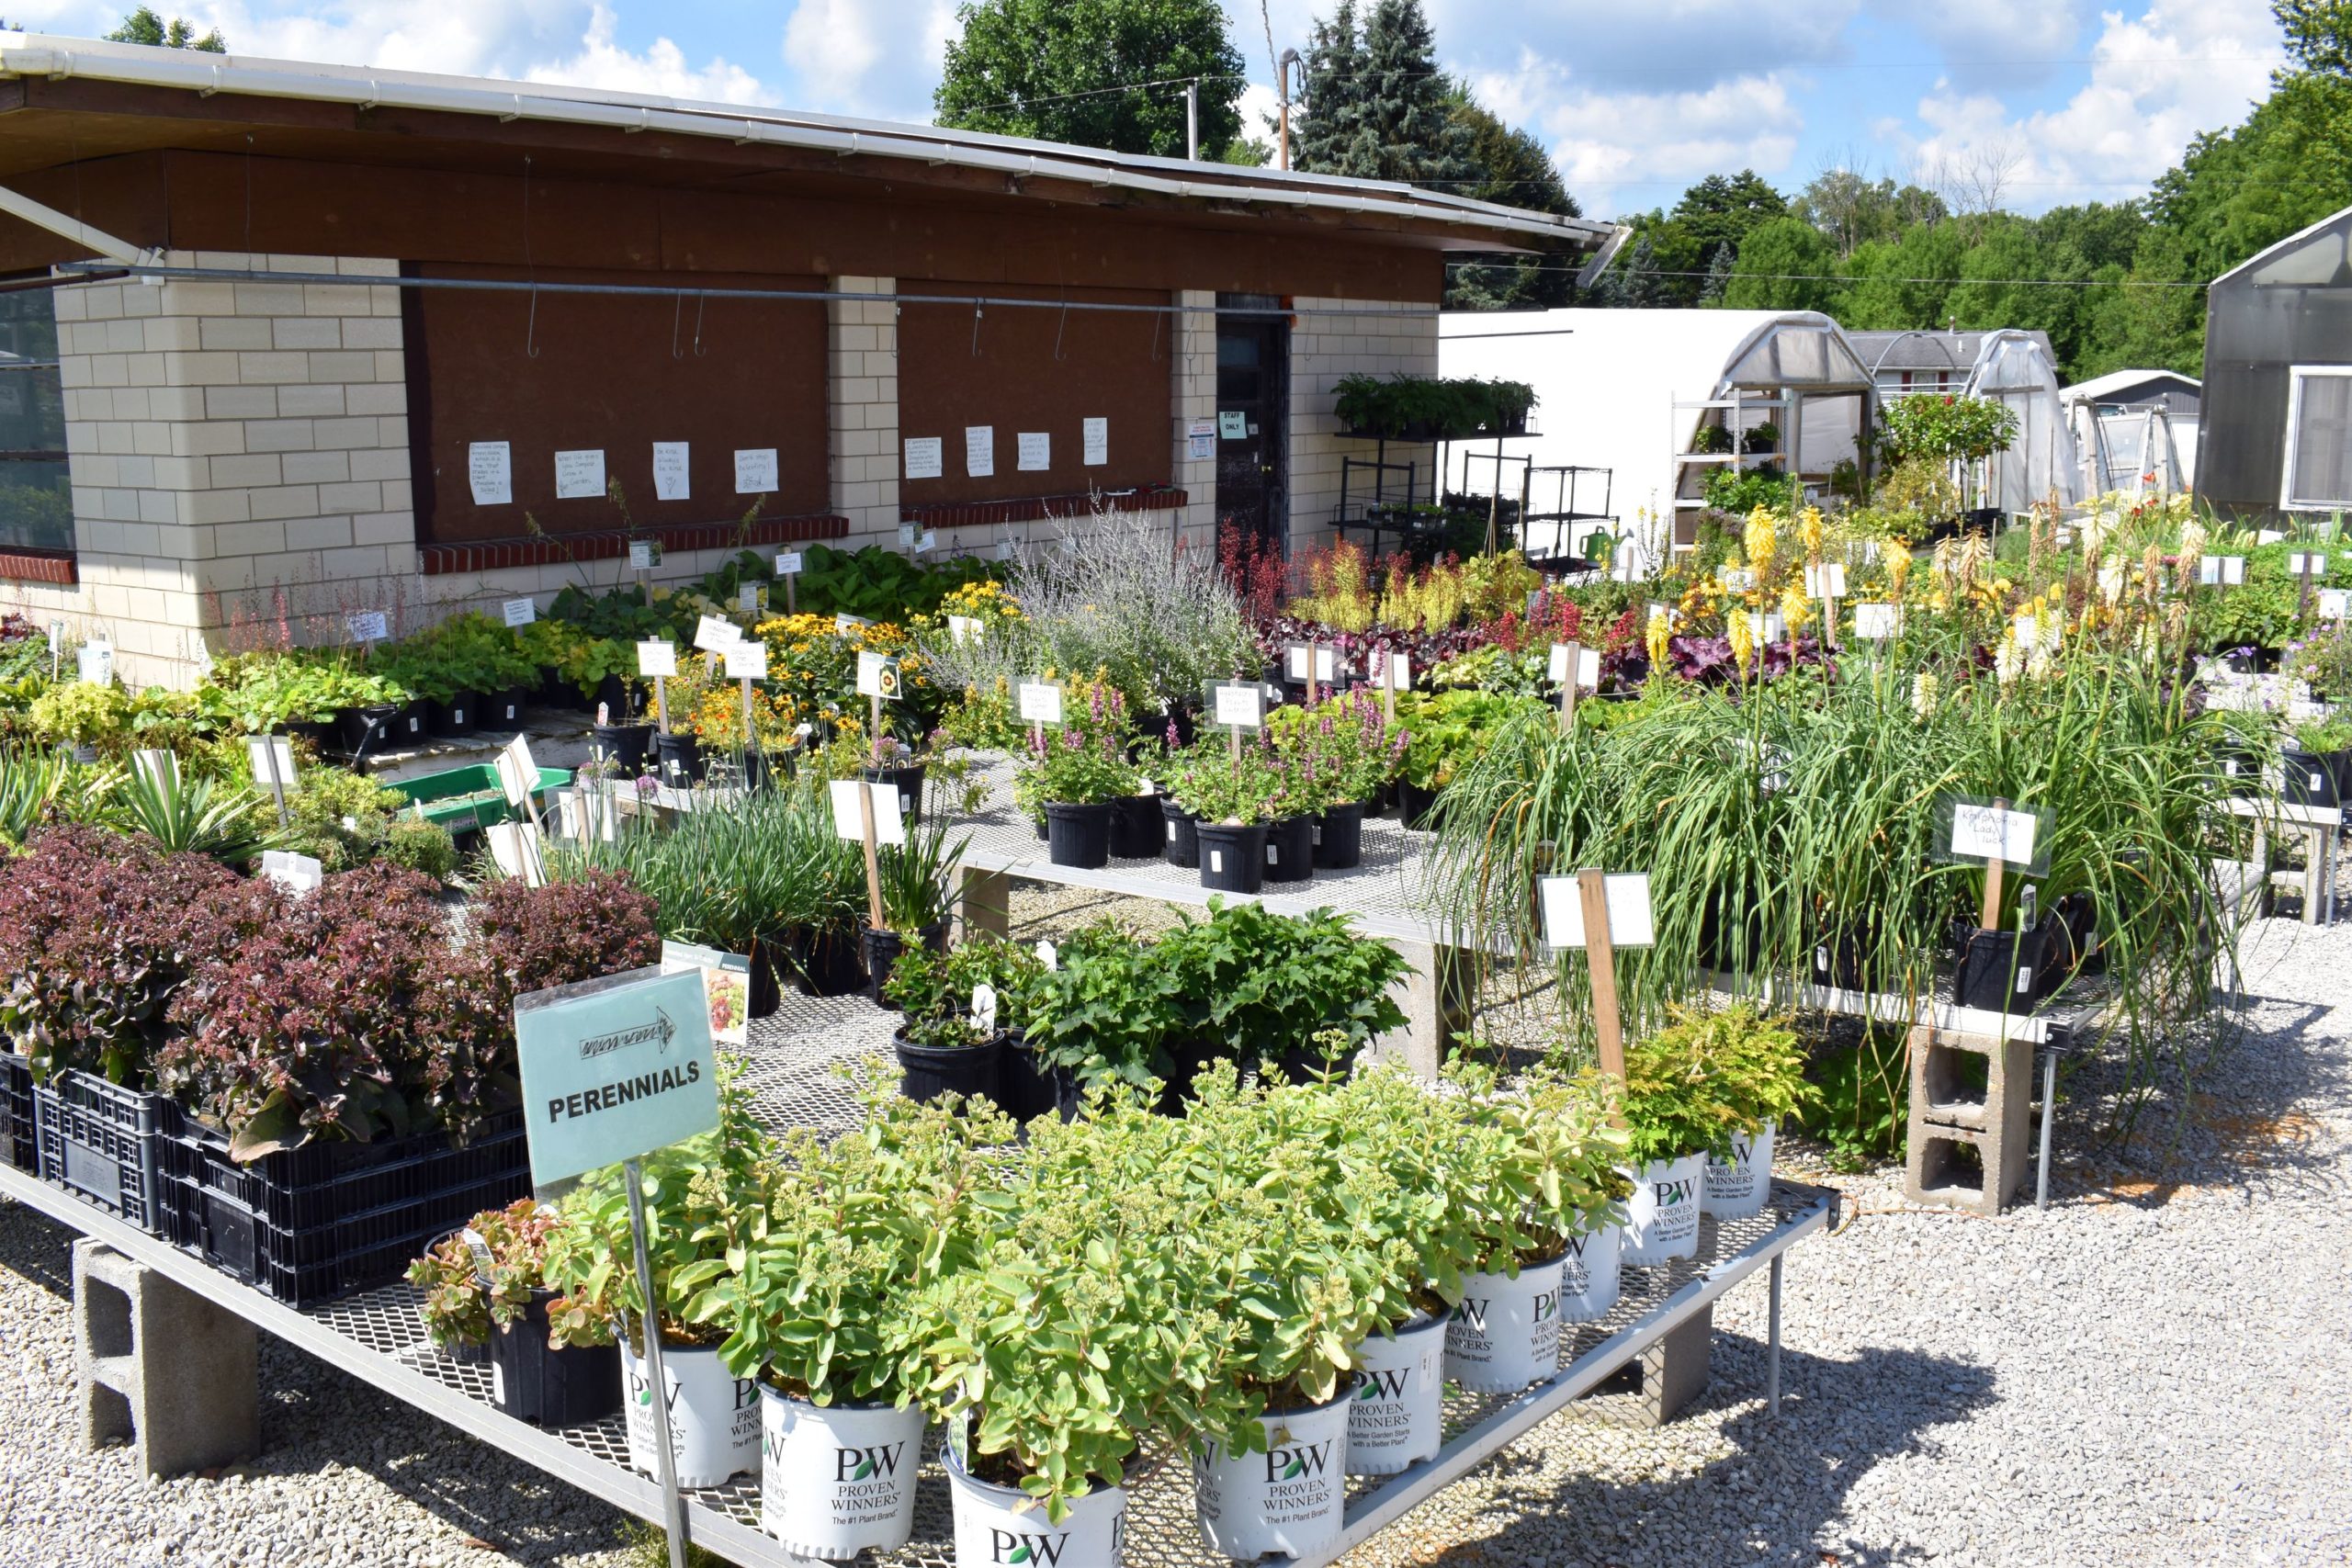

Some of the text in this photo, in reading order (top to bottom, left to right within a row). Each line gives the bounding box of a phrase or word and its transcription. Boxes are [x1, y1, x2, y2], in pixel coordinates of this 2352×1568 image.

[721, 963, 746, 972] PERENNIAL
[548, 1060, 700, 1123] PERENNIALS
[1710, 1167, 1750, 1177] PROEN
[1658, 1202, 1692, 1217] PROVEN
[1447, 1324, 1485, 1338] ROVEN
[737, 1405, 762, 1423] PROV
[1350, 1403, 1404, 1416] PROVEN
[731, 1417, 763, 1437] WINN
[833, 1440, 906, 1482] PW
[1264, 1439, 1331, 1483] PW
[839, 1480, 896, 1496] PROVEN
[1270, 1478, 1326, 1497] PROVEN
[832, 1517, 846, 1525] The
[847, 1517, 856, 1525] #1
[859, 1514, 876, 1524] Plant
[1293, 1513, 1310, 1522] Plant
[989, 1527, 1070, 1568] PW
